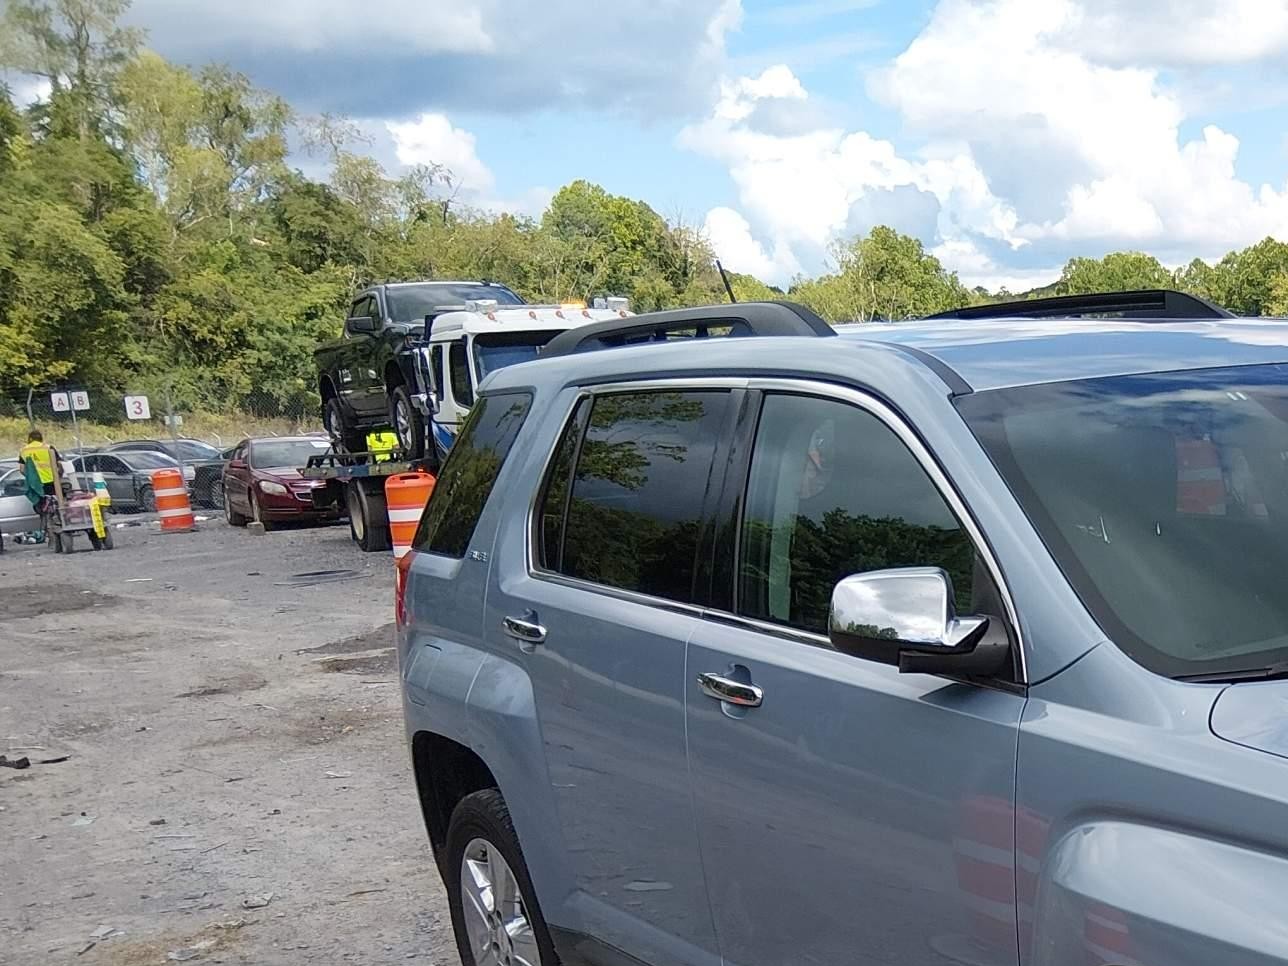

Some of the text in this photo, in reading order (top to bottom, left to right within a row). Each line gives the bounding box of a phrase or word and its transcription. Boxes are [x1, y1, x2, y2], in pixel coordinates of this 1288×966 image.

[57, 397, 65, 407] A
[76, 395, 85, 406] B
[133, 400, 143, 415] 3
